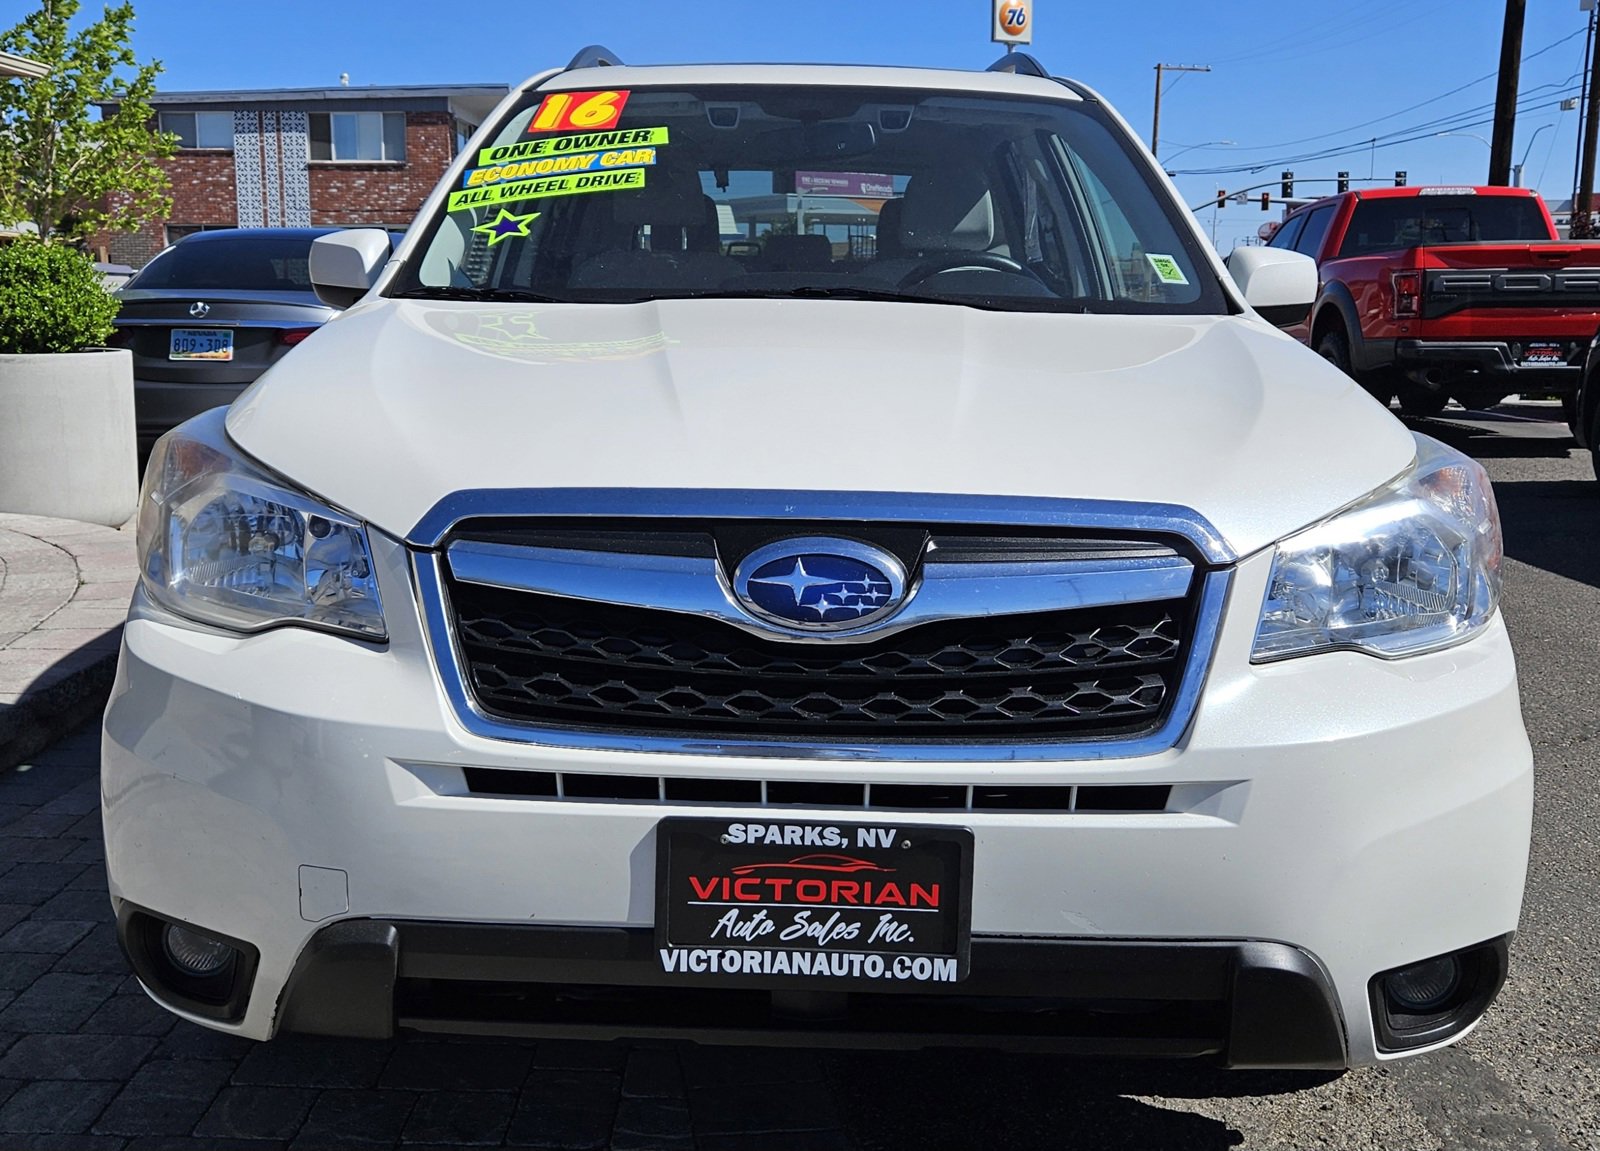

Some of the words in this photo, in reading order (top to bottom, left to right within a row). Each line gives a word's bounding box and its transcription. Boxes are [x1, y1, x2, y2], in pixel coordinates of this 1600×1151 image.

[1007, 7, 1026, 26] 76
[533, 91, 621, 130] 16
[490, 141, 549, 160] ONE
[553, 129, 653, 151] OWNER
[467, 154, 599, 186] ECONOMY
[600, 148, 656, 166] CAR
[455, 189, 494, 207] ALL
[500, 179, 571, 198] WHEEL
[574, 172, 640, 188] DRIVE
[727, 823, 849, 848] SPARKS,
[857, 828, 897, 848] NV
[688, 876, 940, 907] VICTORIAN
[710, 908, 776, 941] Auto
[780, 911, 861, 945] Sales
[867, 913, 915, 944] Inc.
[659, 949, 958, 982] VICTORIANAUTO.COM
